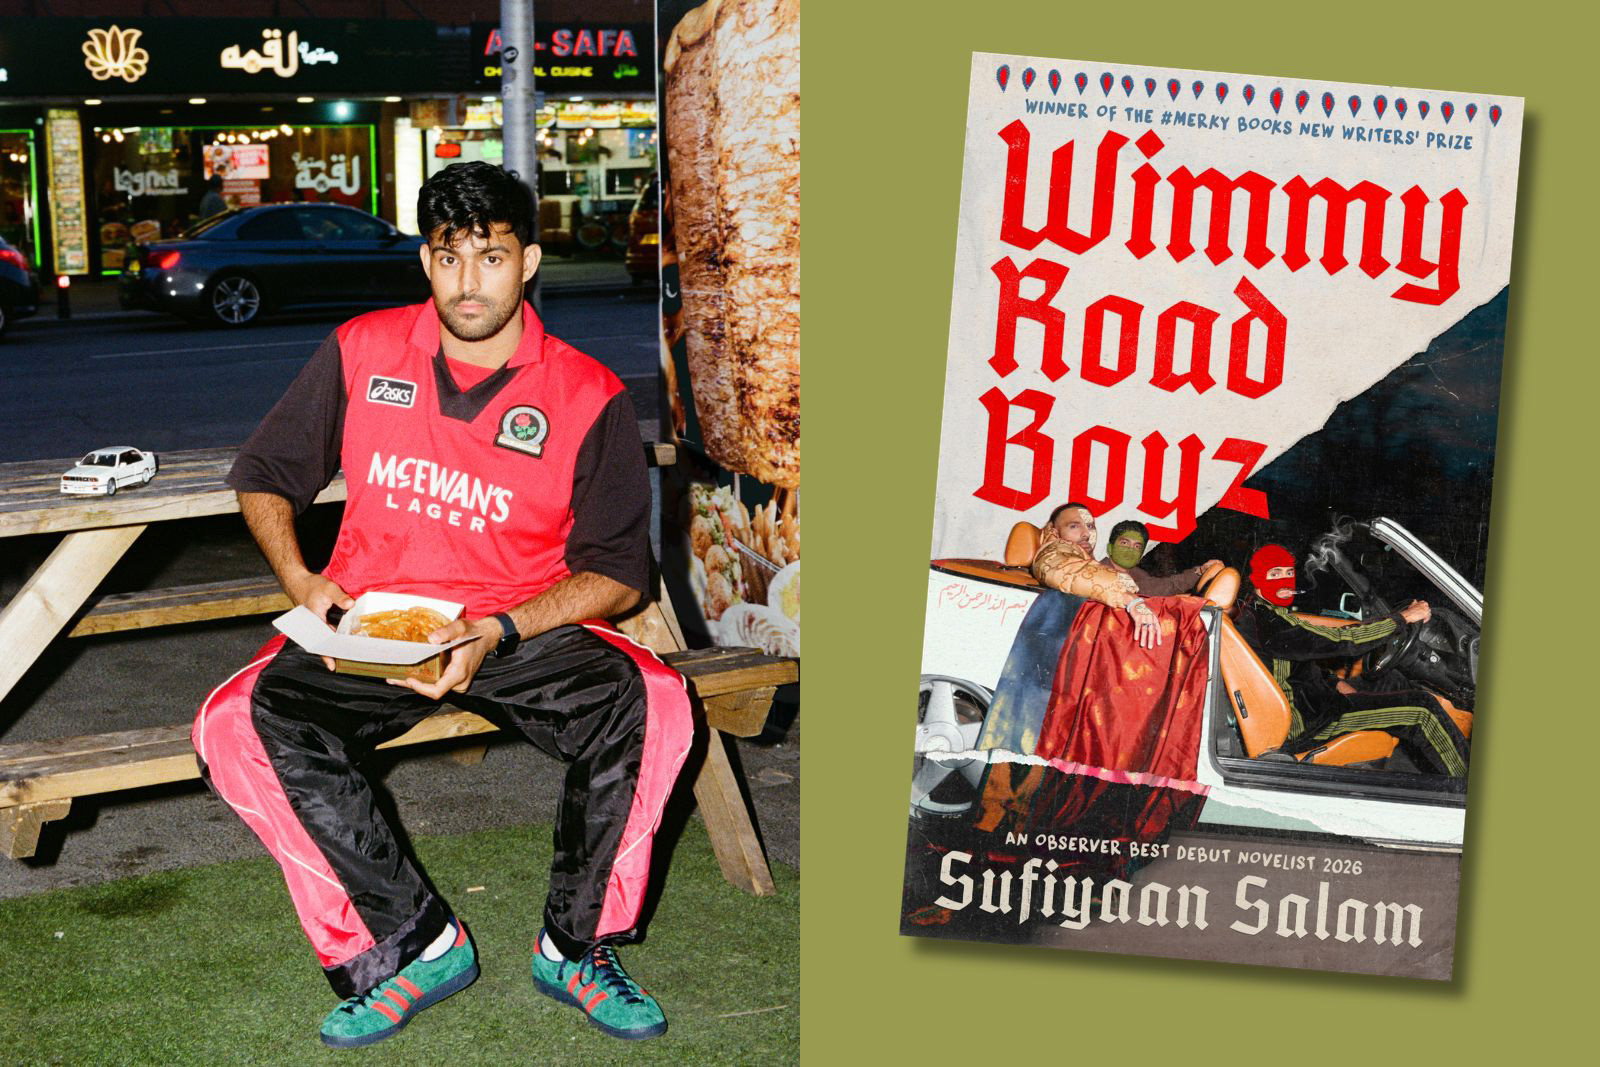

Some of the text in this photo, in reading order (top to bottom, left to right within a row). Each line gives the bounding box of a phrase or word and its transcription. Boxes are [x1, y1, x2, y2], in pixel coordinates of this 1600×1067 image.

[484, 29, 638, 57] A-SAFA
[1025, 98, 1473, 150] WINNER OF THE #MERKY BOOKS NEW WRITERS' PRIZE
[997, 118, 1469, 306] Wimmy
[987, 255, 1288, 400] Road
[972, 386, 1270, 544] Boyz
[386, 493, 486, 533] LAGER
[1005, 831, 1363, 875] AN OBSERVER BEST DEBUT NOVELIST 2026
[934, 849, 1424, 949] Sufiyaan Salam
